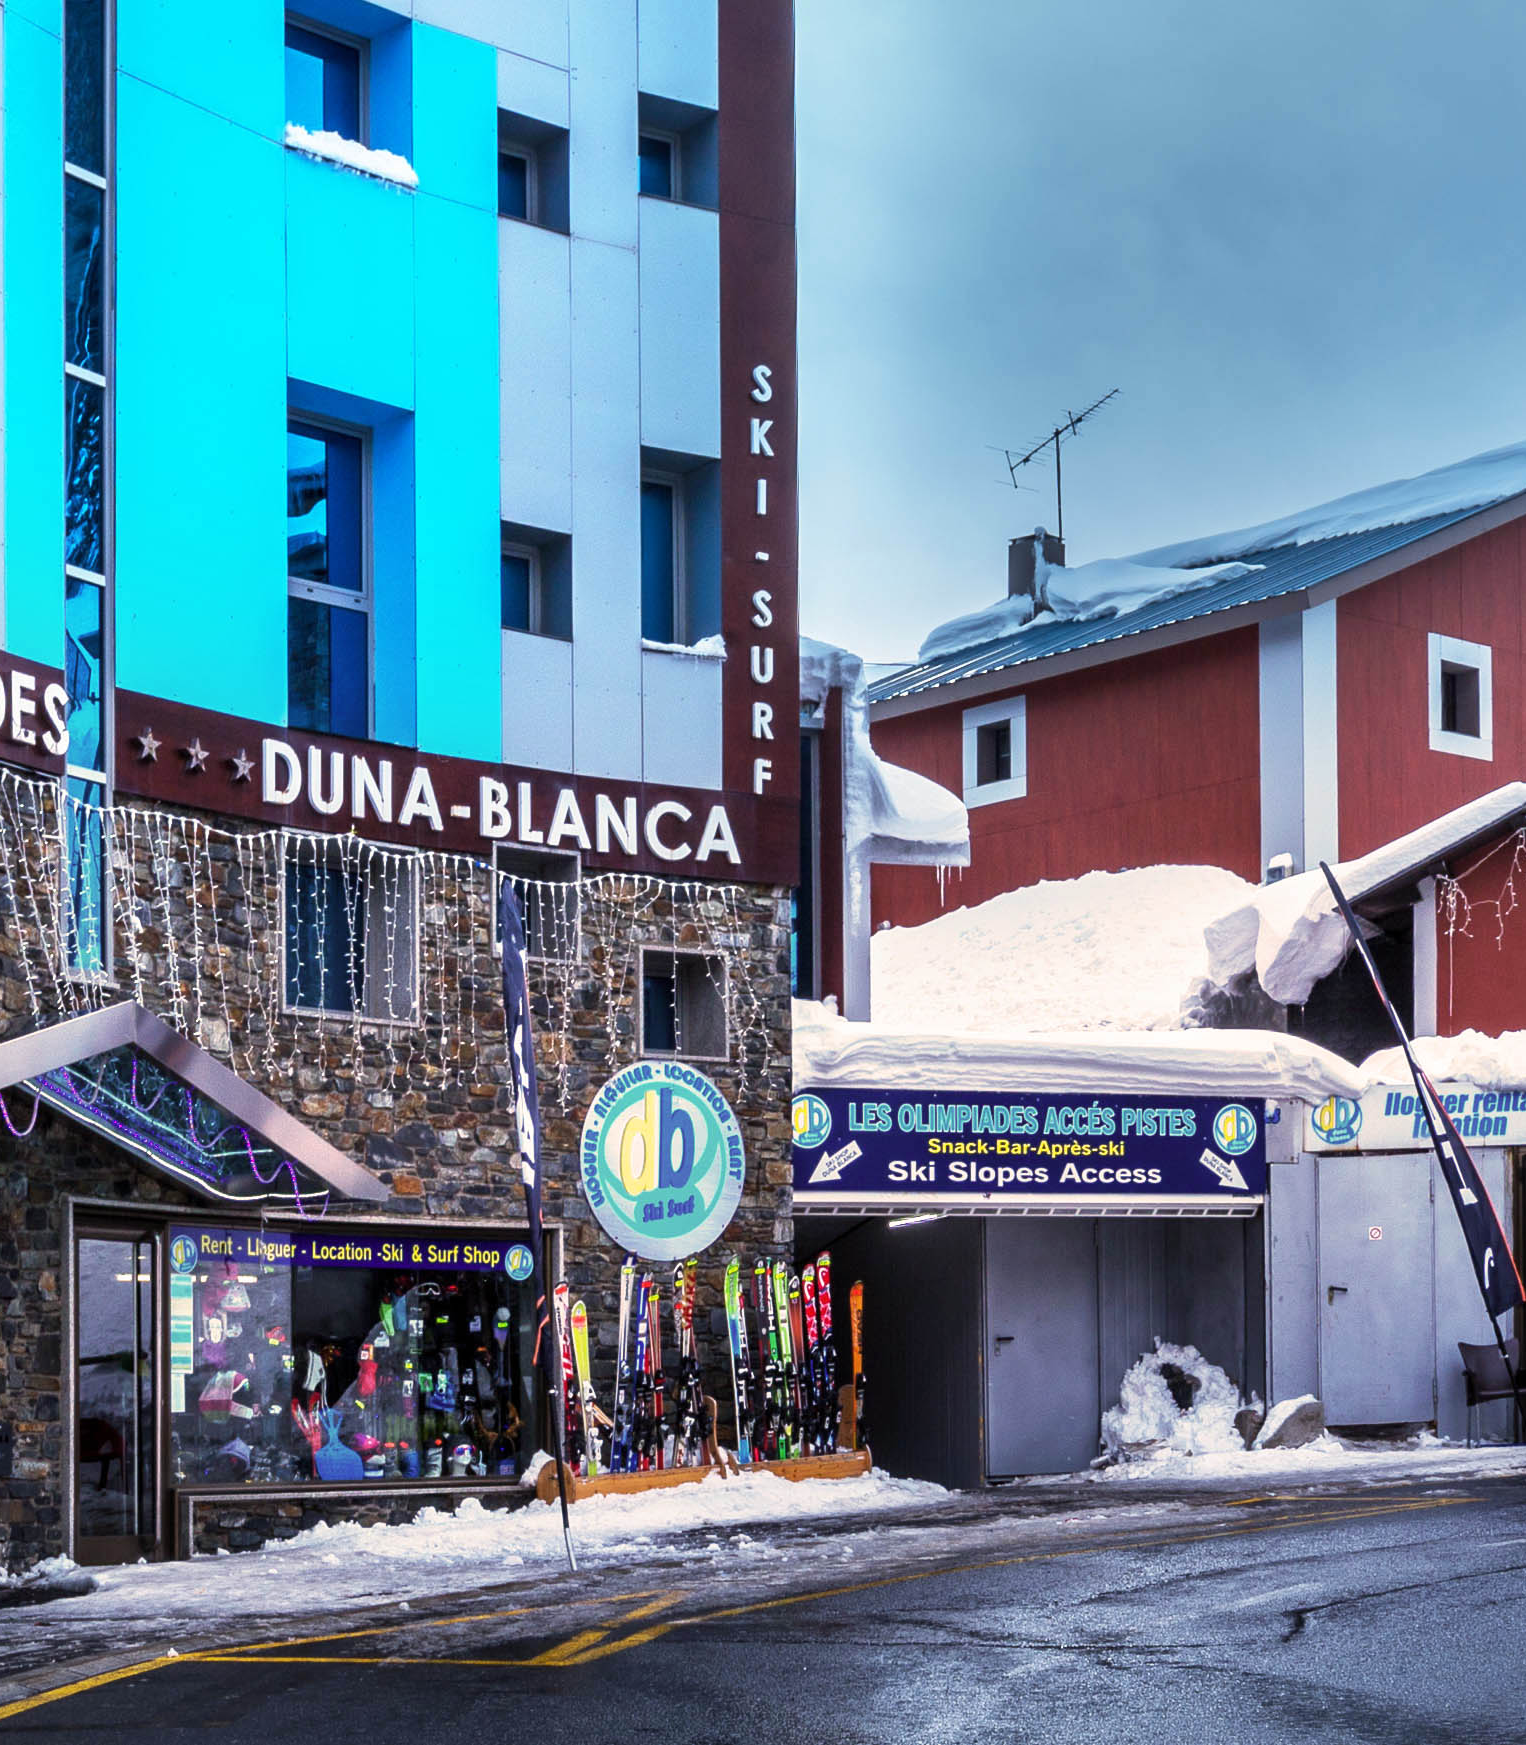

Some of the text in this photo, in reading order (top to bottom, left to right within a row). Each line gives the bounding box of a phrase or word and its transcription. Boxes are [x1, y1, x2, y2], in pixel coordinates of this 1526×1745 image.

[261, 737, 742, 865] DUNA-BLANCA
[664, 1063, 731, 1124] LOCATION
[727, 1135, 743, 1181] RENT
[848, 1100, 1197, 1137] LES OLIMPIADES ACCÉS PISTES
[1412, 1113, 1508, 1139] loation
[620, 1087, 695, 1196] db
[927, 1138, 1125, 1158] Snack-Bar-Après-ski
[887, 1160, 1162, 1187] Ski Slopes Access
[201, 1234, 233, 1255] Rent
[312, 1241, 372, 1261] Location
[411, 1244, 423, 1263] &
[427, 1244, 459, 1263] Surf
[463, 1245, 500, 1268] Shop
